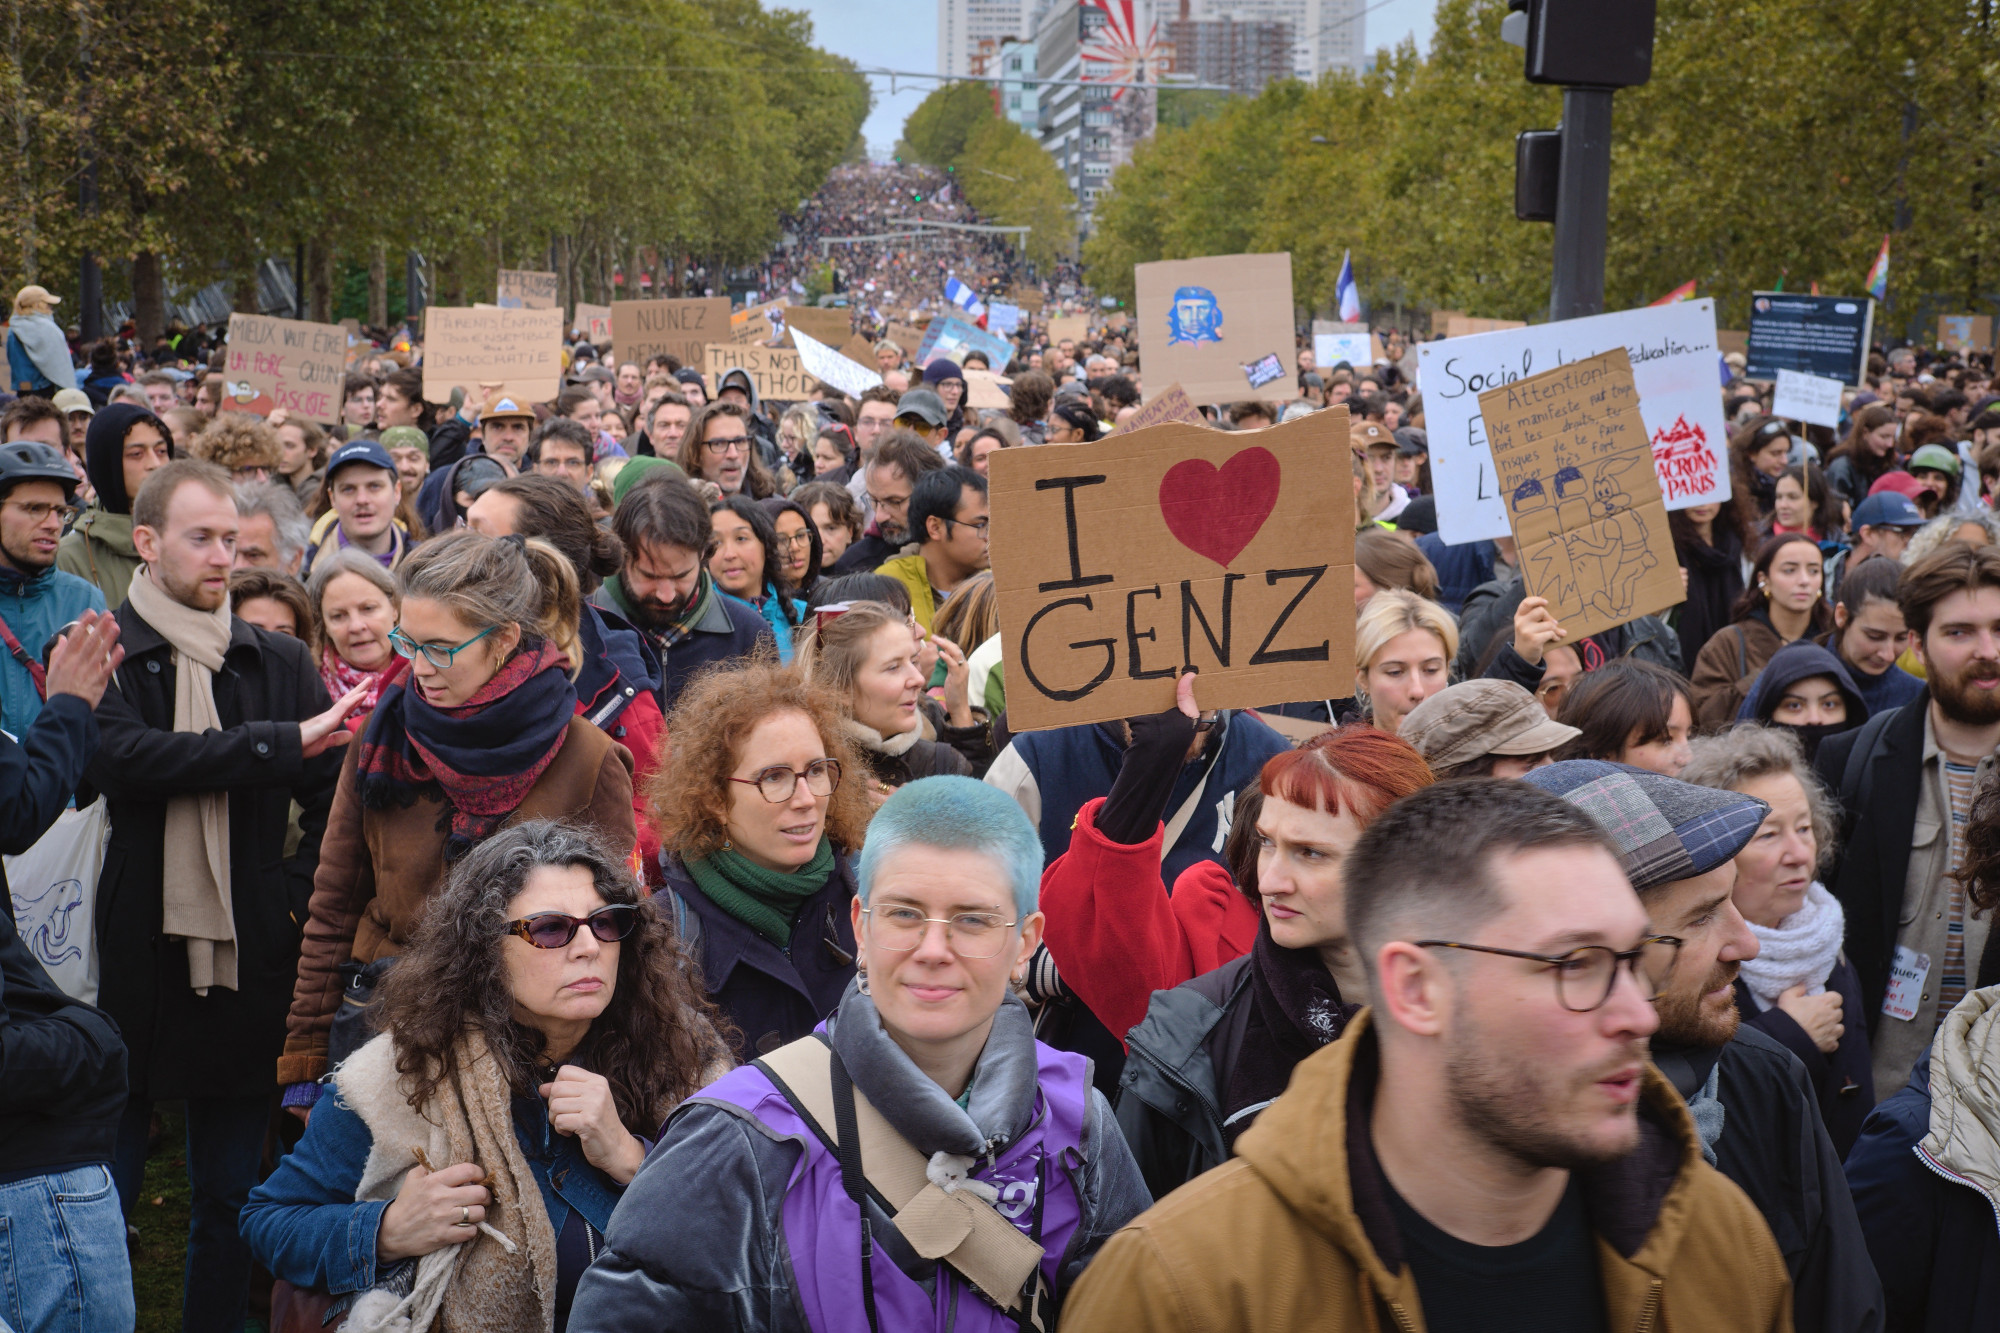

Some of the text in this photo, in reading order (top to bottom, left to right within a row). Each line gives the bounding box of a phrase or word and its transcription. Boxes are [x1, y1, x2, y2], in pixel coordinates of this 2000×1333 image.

[230, 320, 276, 345] MIEUX
[230, 351, 249, 372] UN
[254, 351, 286, 378] PORC
[708, 349, 800, 371] THIS NOT
[1439, 348, 1532, 399] Social
[1507, 359, 1608, 410] Attention!
[1492, 421, 1511, 437] Ne
[1517, 400, 1581, 428] manifeste
[1494, 436, 1515, 454] fort
[1524, 430, 1543, 444] tes
[1606, 407, 1622, 419] tu
[1501, 424, 1626, 473] risques de te faire
[1555, 452, 1581, 469] très
[1668, 472, 1715, 501] PARIS
[1035, 474, 1114, 593] I
